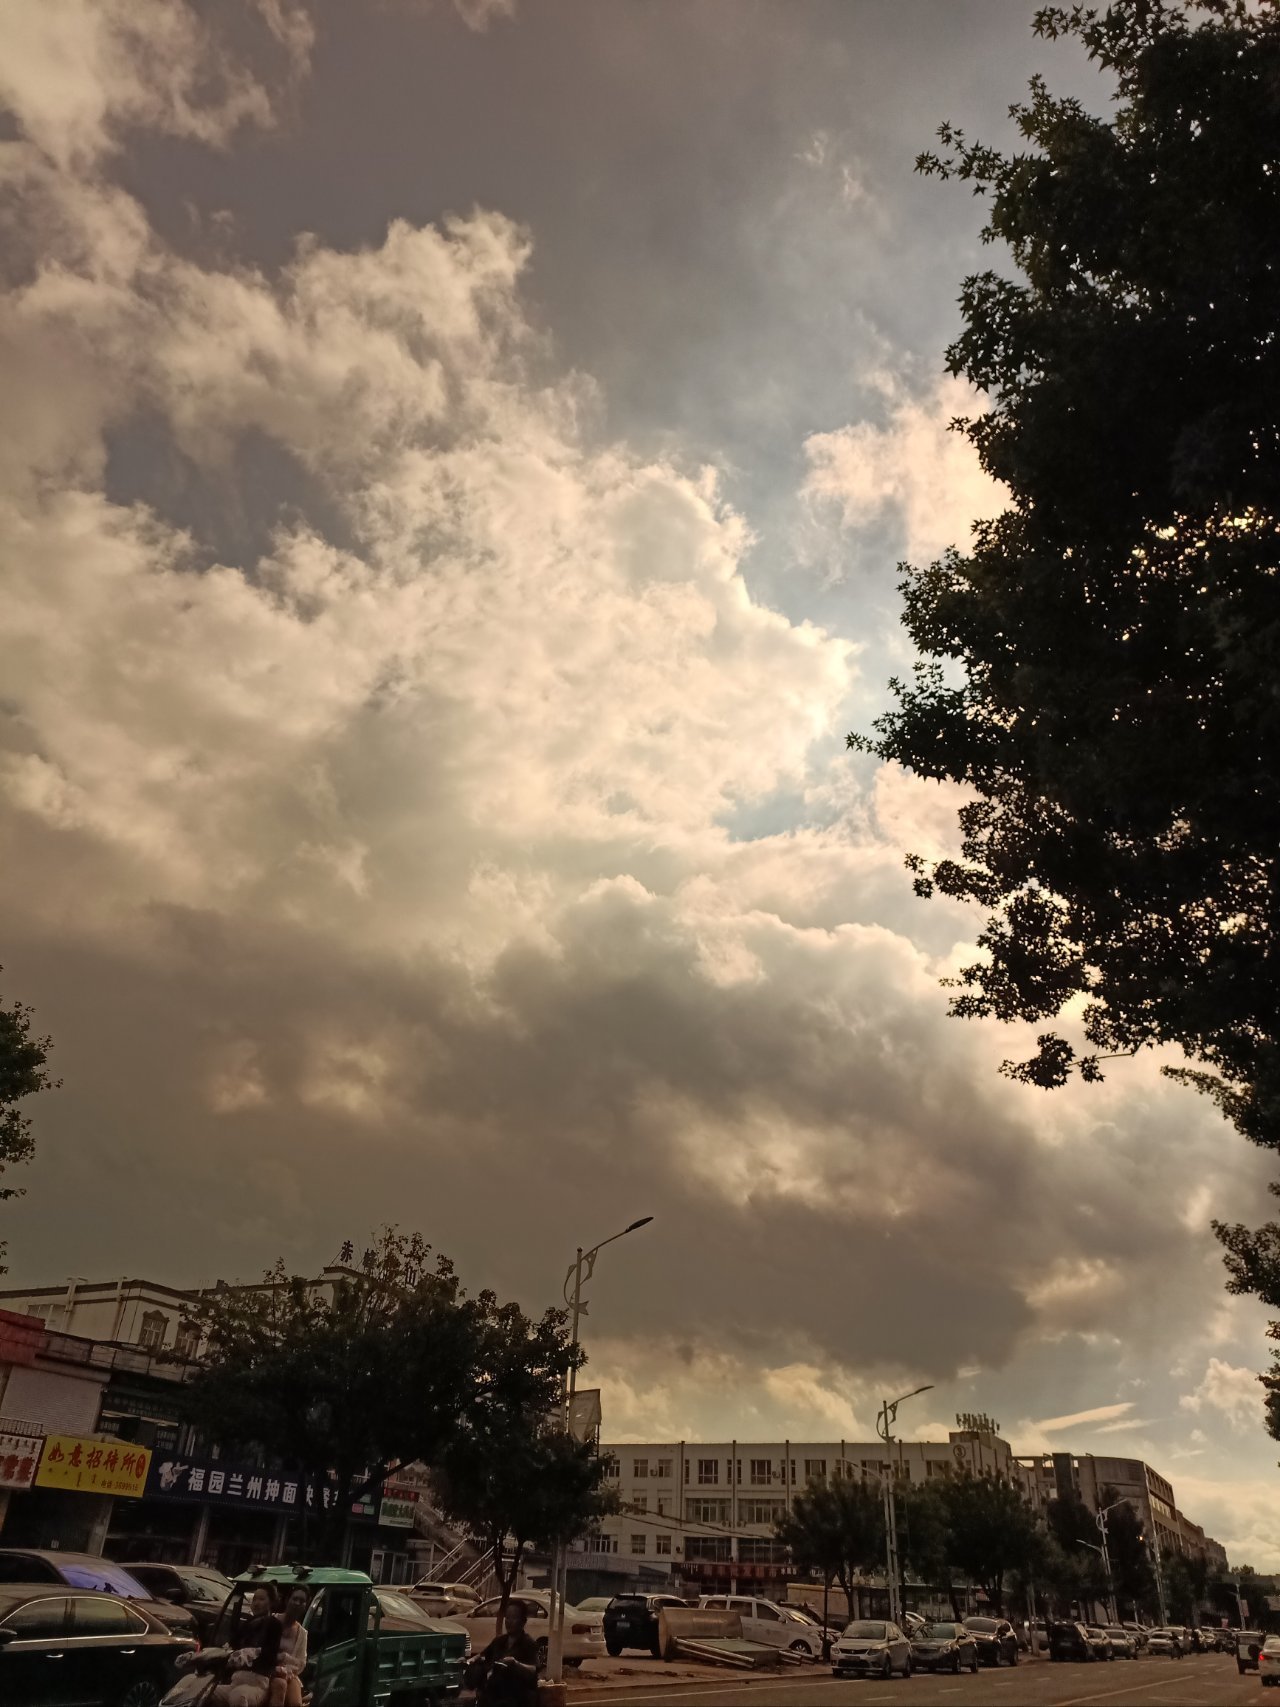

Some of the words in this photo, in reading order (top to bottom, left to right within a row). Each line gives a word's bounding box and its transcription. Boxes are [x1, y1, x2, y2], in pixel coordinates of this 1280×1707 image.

[48, 1442, 136, 1476] 如意招待所
